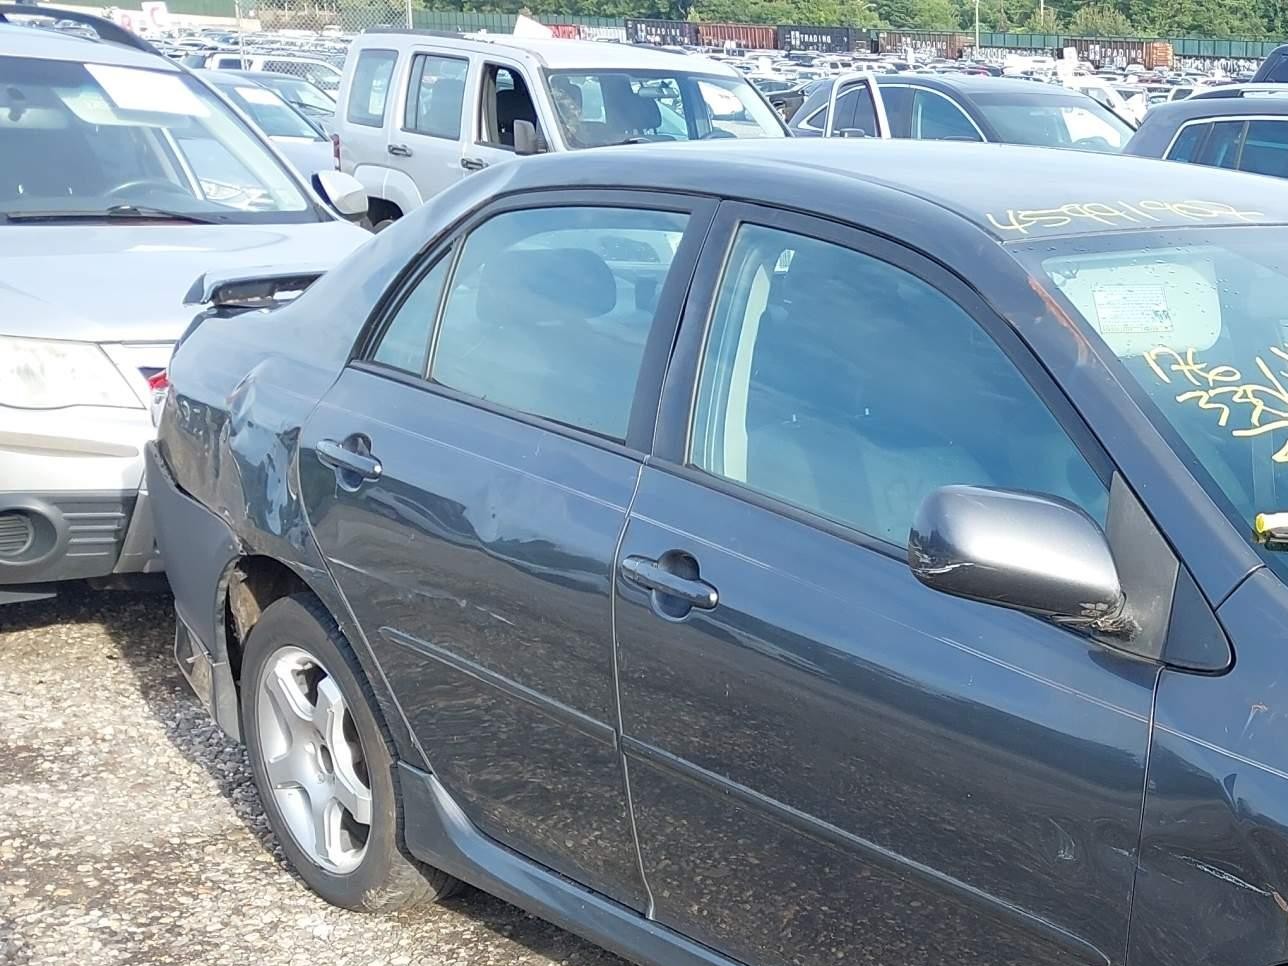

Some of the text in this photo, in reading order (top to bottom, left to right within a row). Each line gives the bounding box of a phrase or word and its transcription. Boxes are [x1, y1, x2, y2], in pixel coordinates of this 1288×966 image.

[800, 34, 832, 44] TRADING
[912, 40, 947, 50] TRADING
[1101, 48, 1143, 58] TRADING
